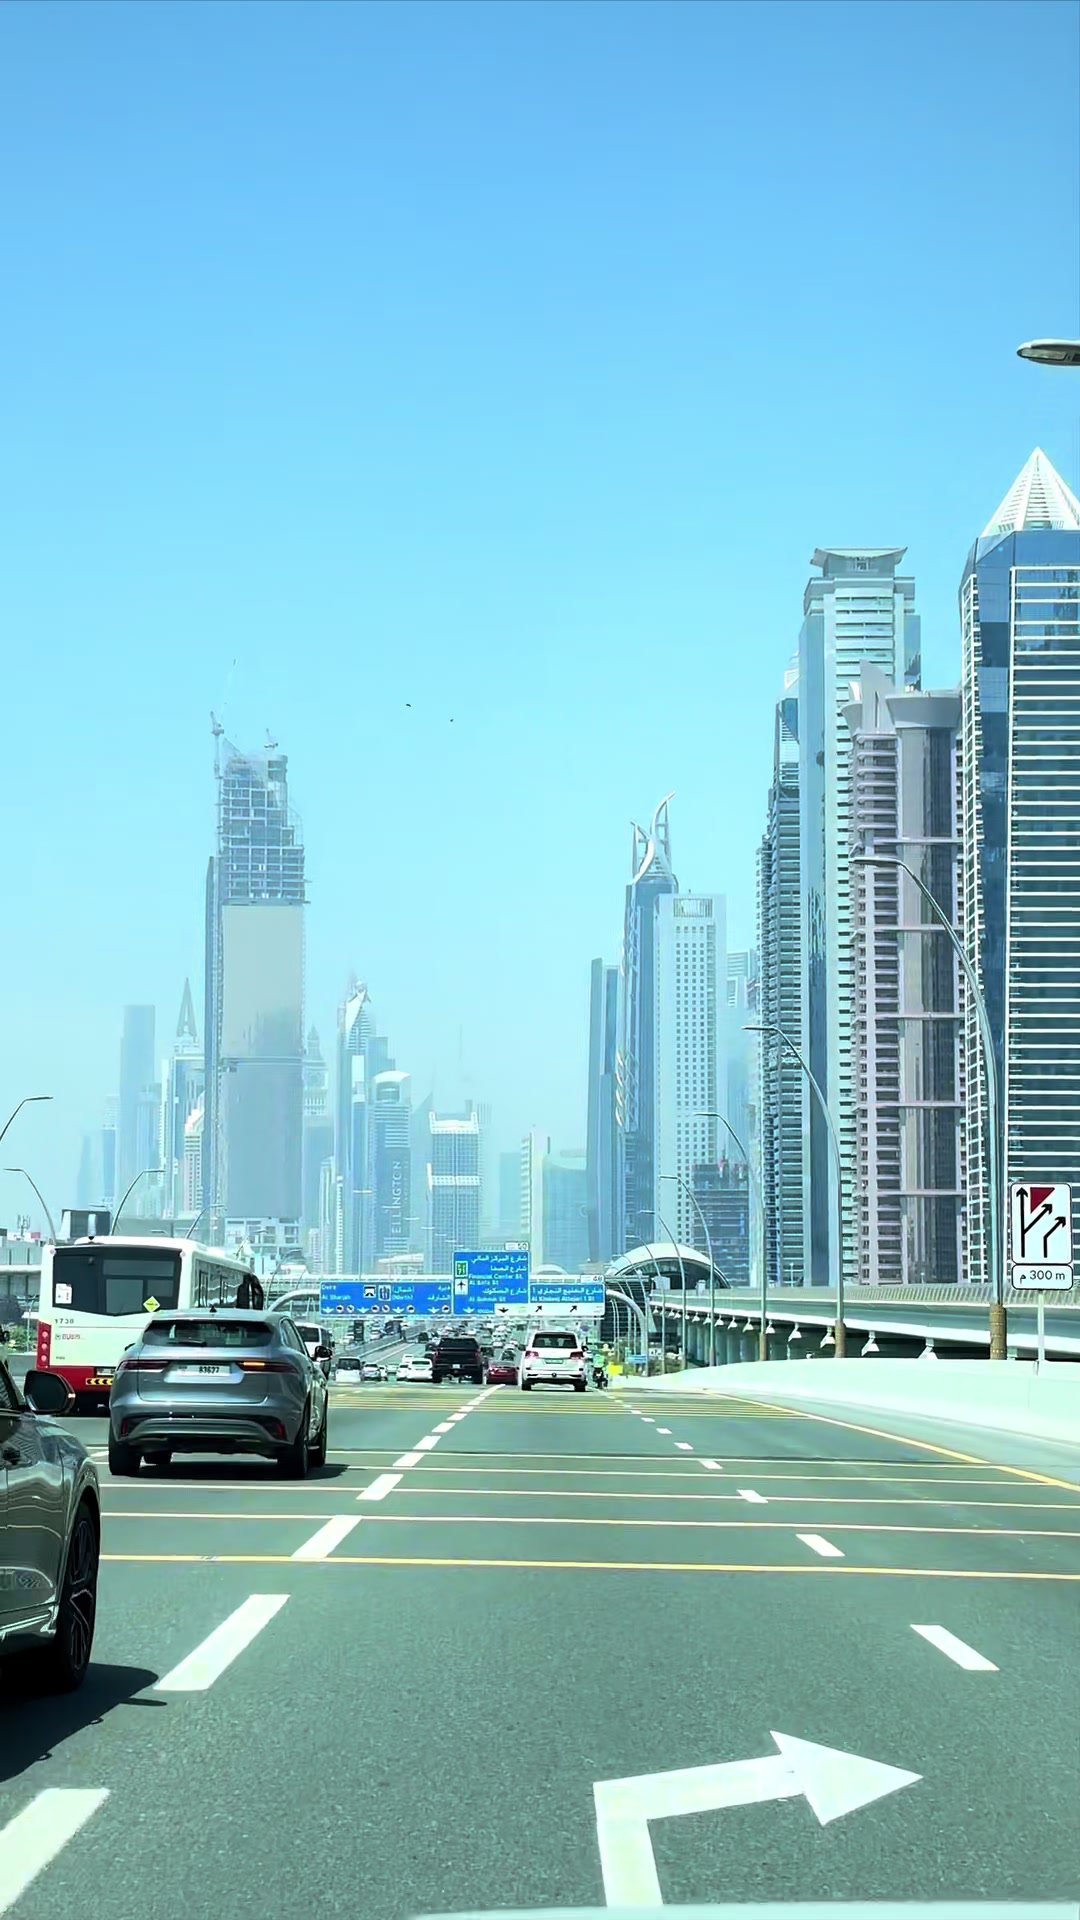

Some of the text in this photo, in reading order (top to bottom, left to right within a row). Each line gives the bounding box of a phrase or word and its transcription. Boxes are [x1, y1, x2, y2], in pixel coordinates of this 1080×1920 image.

[391, 1161, 402, 1234] ELLINGTON
[1029, 1270, 1053, 1281] 300
[1055, 1272, 1066, 1280] m
